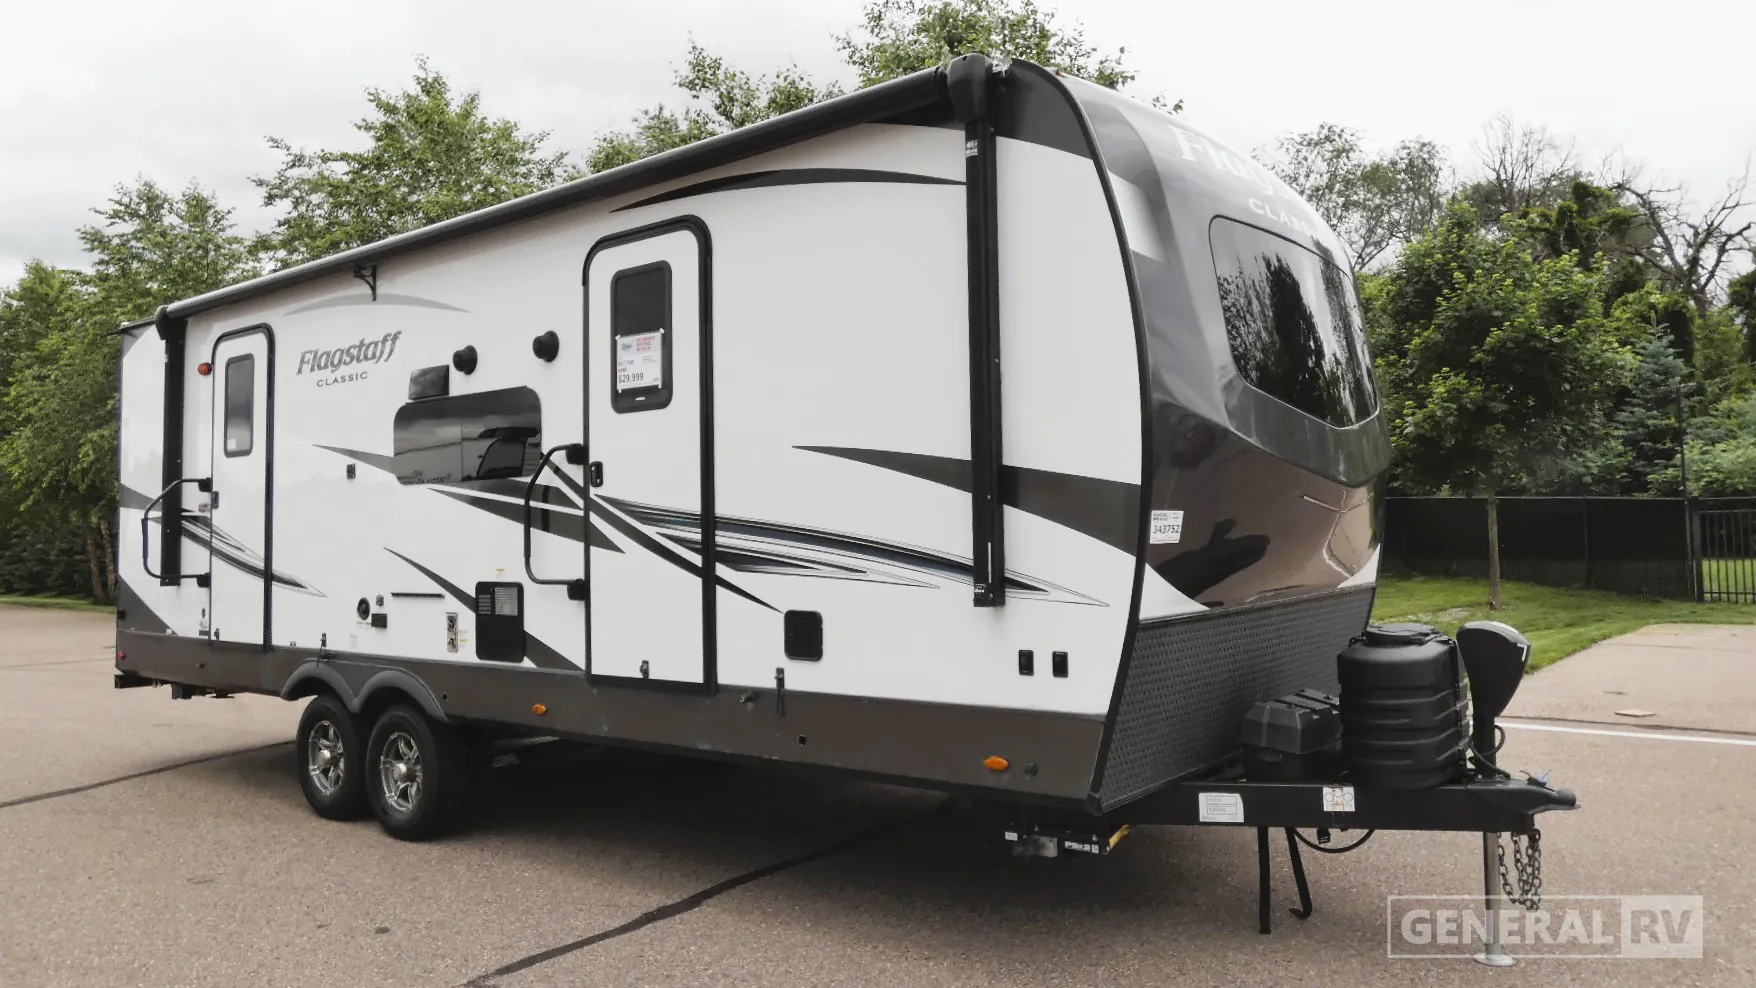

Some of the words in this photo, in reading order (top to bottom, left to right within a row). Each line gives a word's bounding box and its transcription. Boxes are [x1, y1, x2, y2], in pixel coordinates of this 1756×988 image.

[296, 329, 402, 375] Flagstaff
[316, 371, 369, 388] CLASSIC
[618, 372, 644, 384] $29,999
[1152, 524, 1180, 534] 343752
